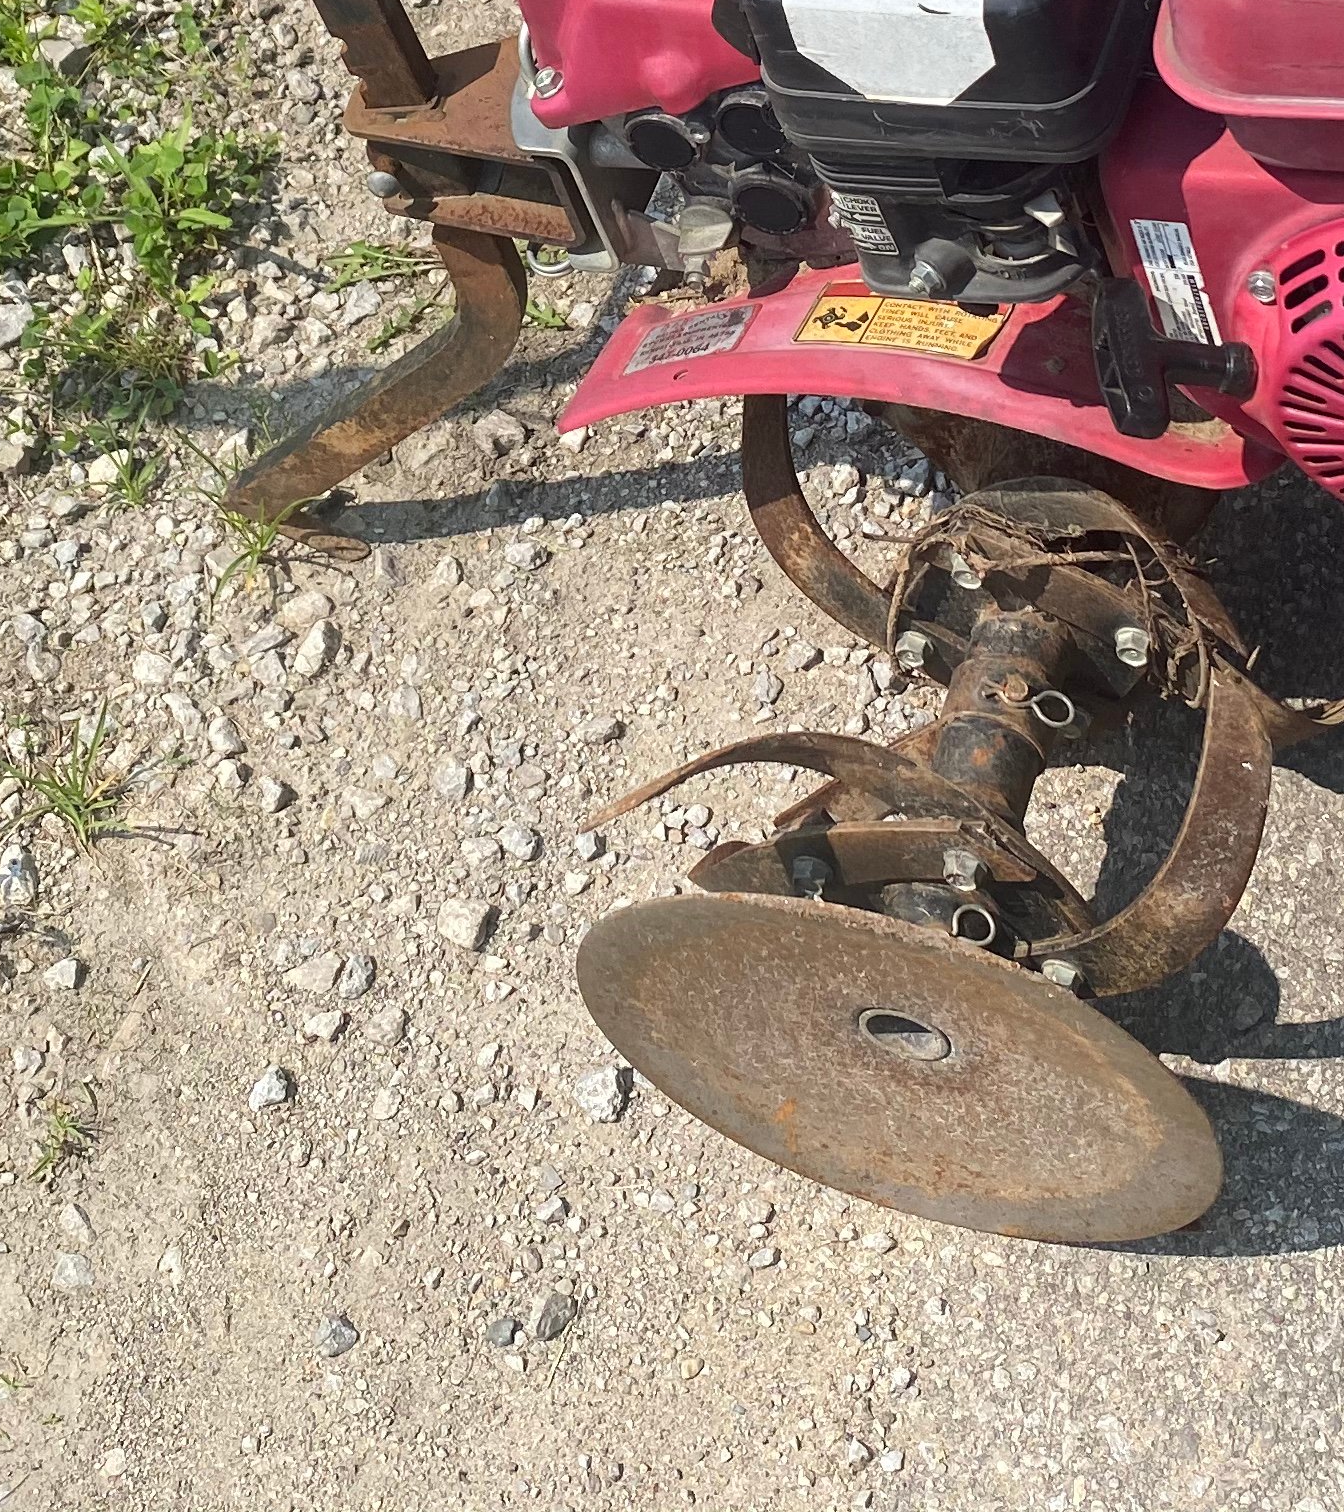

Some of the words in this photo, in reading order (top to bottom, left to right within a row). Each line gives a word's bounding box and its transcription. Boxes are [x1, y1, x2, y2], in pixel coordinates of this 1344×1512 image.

[843, 196, 876, 205] CHOKE
[845, 203, 877, 212] LEVER
[861, 227, 886, 235] FUEL
[861, 233, 892, 241] VALVE
[884, 302, 923, 311] CONTACT
[928, 306, 951, 314] WITH
[877, 315, 913, 324] SERIOUS
[881, 309, 905, 317] TINES
[911, 311, 932, 319] WILL
[935, 315, 963, 324] CAUSE
[873, 321, 894, 329] KEEP
[959, 331, 978, 341] AND
[865, 335, 897, 343] ENGINE
[869, 328, 912, 338] CLOTHING
[917, 333, 940, 342] AWAY
[945, 338, 974, 347] WHILE
